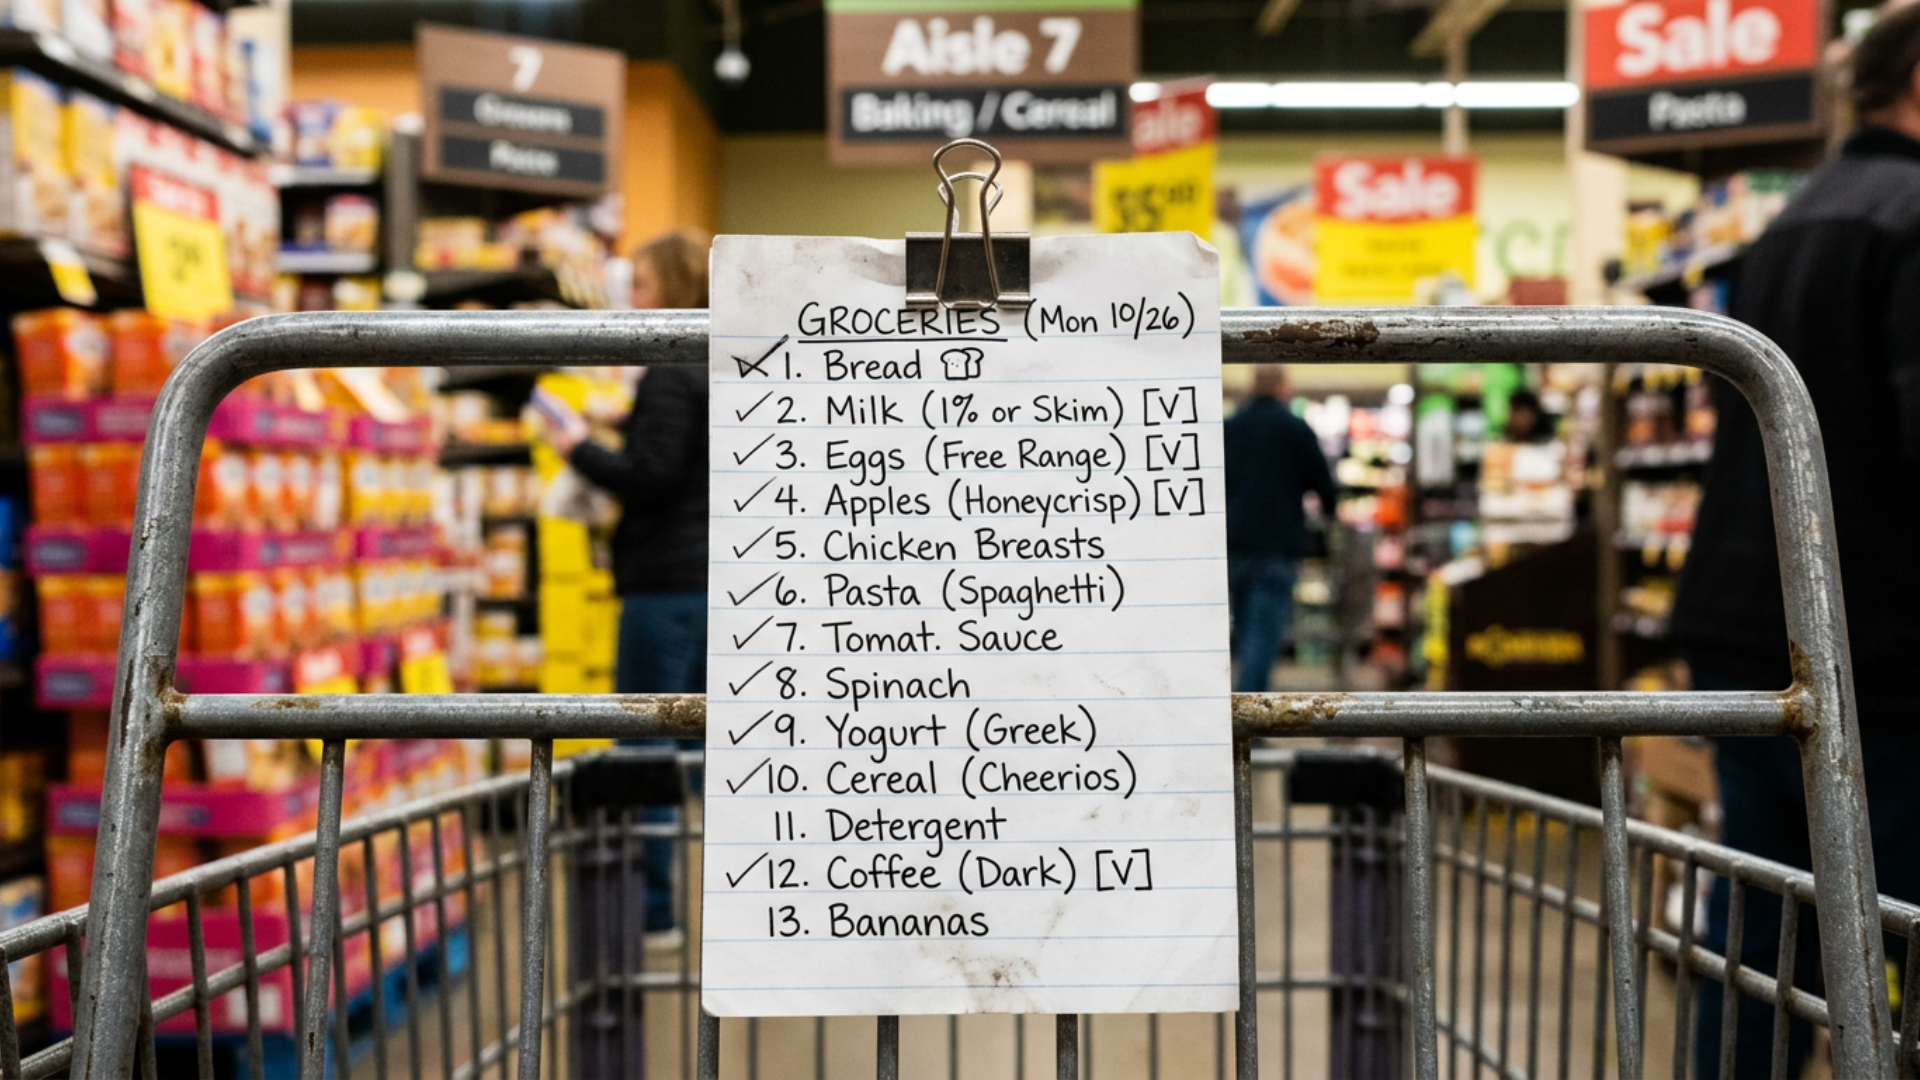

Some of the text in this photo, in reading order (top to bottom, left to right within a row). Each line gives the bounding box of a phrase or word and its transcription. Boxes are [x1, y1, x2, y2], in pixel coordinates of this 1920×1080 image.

[882, 17, 1082, 76] Aisle 7
[1615, 0, 1781, 77] Sale
[508, 46, 544, 91] 7
[851, 92, 974, 139] Baking
[1001, 91, 1117, 130] Cereal
[1333, 160, 1460, 220] Sale
[797, 292, 1196, 343] GROCERIES (Mon 10/26)
[784, 348, 922, 381] 1. Bread
[776, 385, 1198, 430] 2. Milk (1% or Skim) [V]
[775, 432, 1200, 488] 3. Eggs (Free Range) [V]
[773, 475, 1206, 533] 4. Apples (Honeycrisp) [V]
[774, 526, 1106, 562] 5. Chicken Breasts
[775, 563, 1125, 622] 6. Pasta (Spaghetti)
[775, 619, 1064, 654] 7. Tomat. Sauce
[774, 666, 971, 712] 8. Spinach
[773, 705, 1098, 764] 9. Yogurt (Greek)
[766, 749, 1138, 801] 10. Cereal (Cheerios)
[774, 805, 1008, 859] 11. Detergent
[767, 846, 1154, 896] 12. Coffee (Dark) [V]
[767, 901, 990, 939] 13. Bananas
